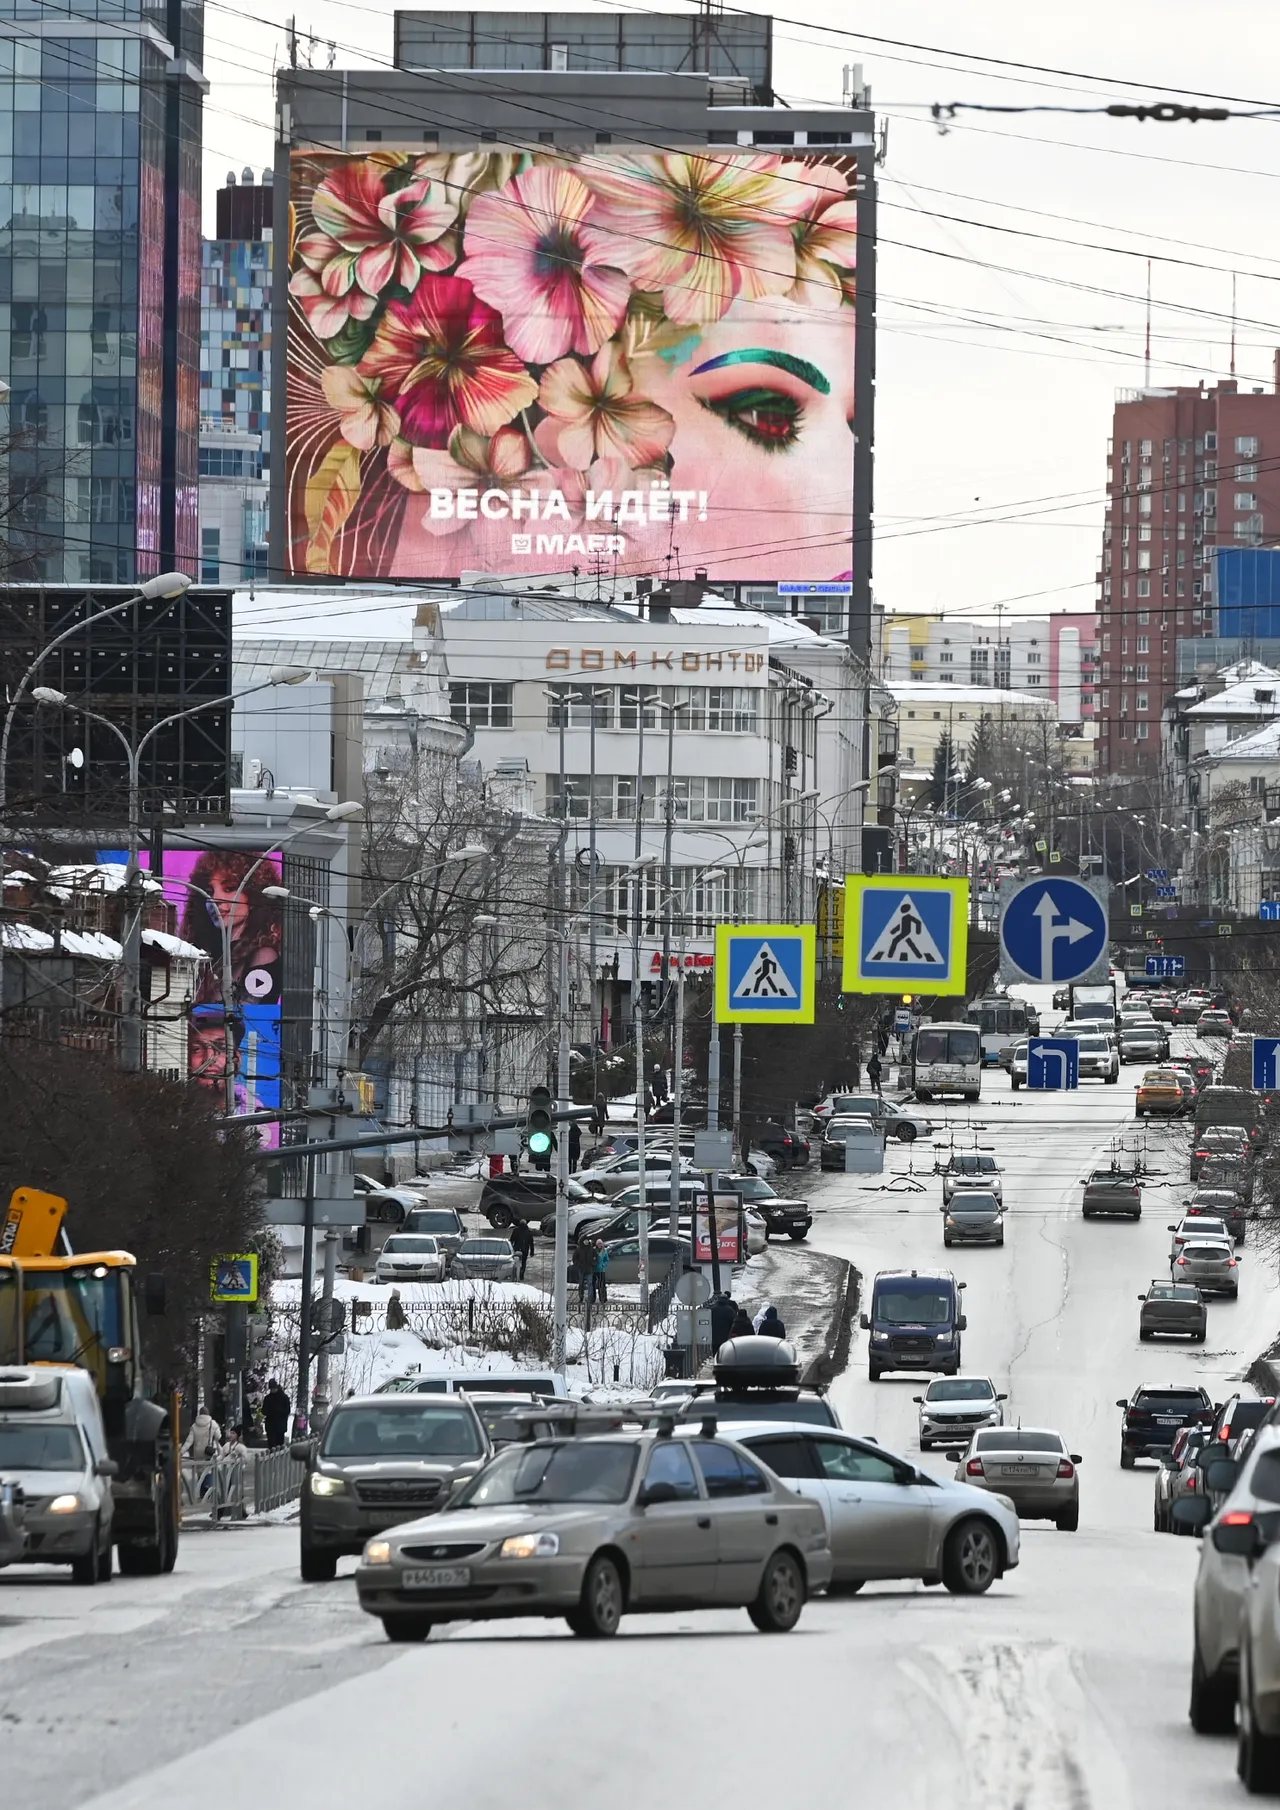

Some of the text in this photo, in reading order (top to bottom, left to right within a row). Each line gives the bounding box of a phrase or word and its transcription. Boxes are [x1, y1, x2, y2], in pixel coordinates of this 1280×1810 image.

[430, 480, 709, 527] ВЕСНА ИДЁТ!
[536, 534, 626, 555] MAER
[546, 649, 764, 673] ДОМ КОНТОР
